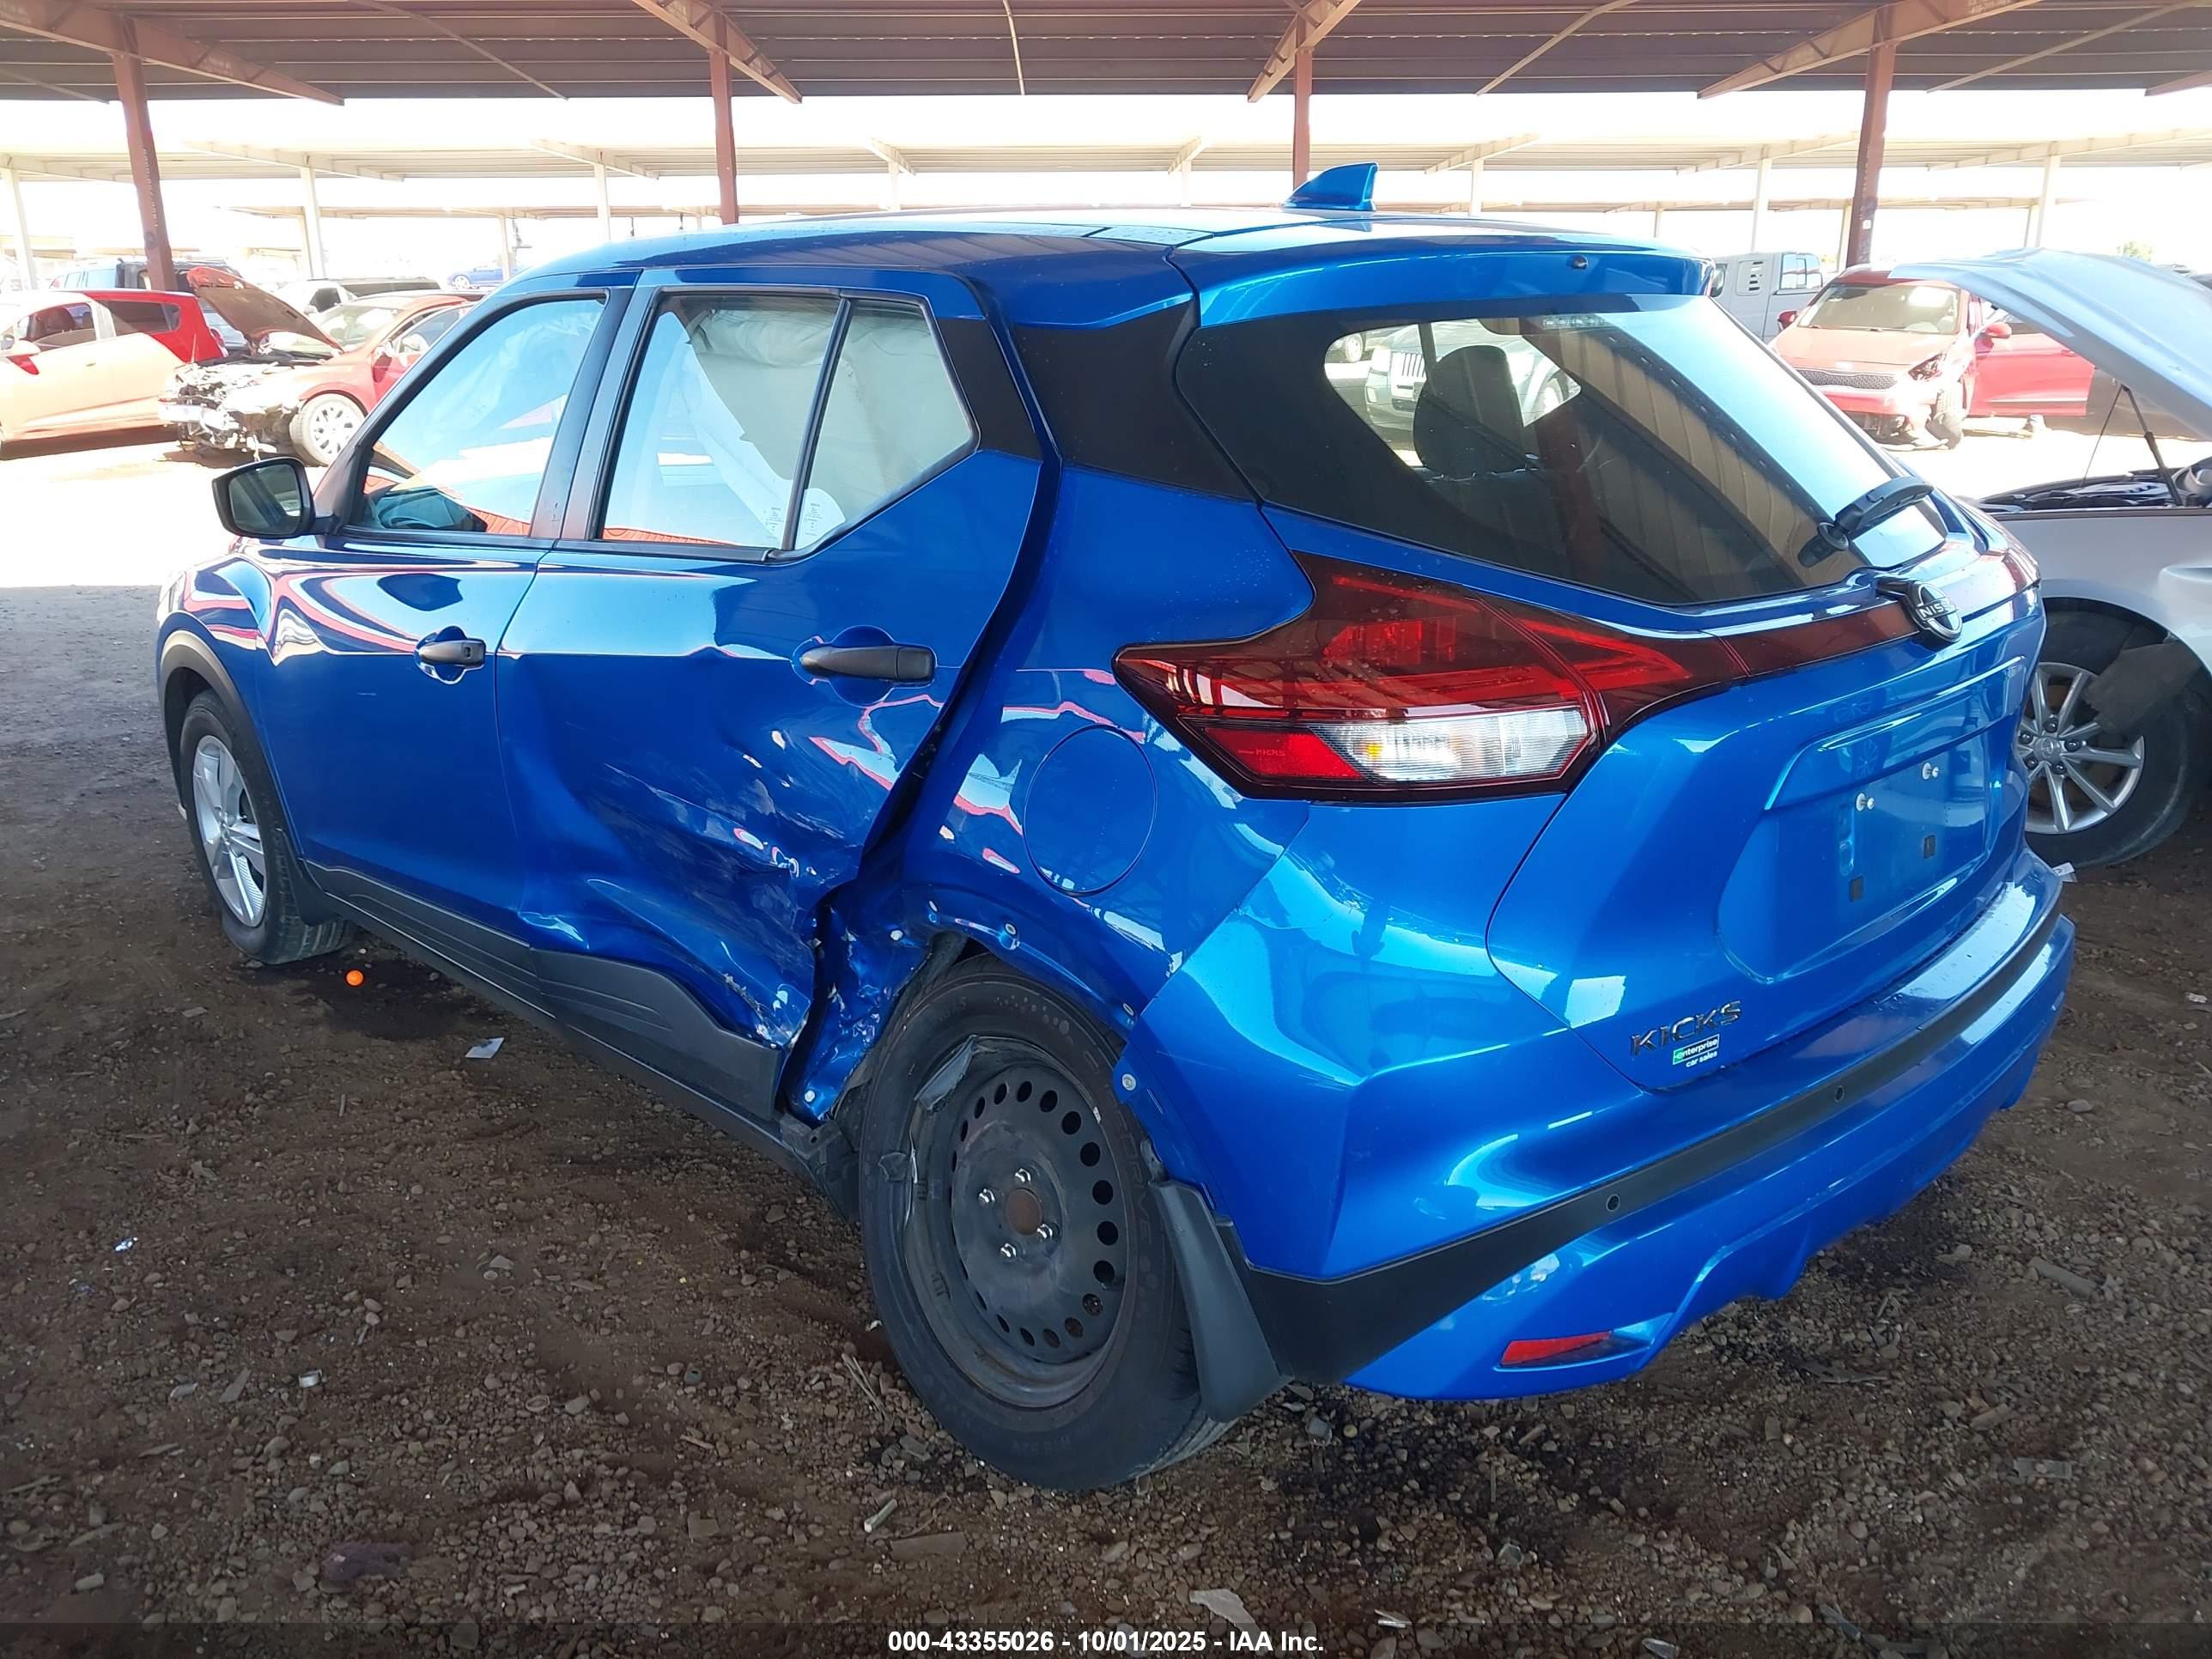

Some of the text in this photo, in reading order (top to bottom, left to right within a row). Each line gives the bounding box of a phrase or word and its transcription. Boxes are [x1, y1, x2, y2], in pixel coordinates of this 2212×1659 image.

[1630, 1000, 1741, 1056] KICKS
[1675, 1037, 1718, 1060] enterprise
[1686, 1050, 1718, 1068] car sales
